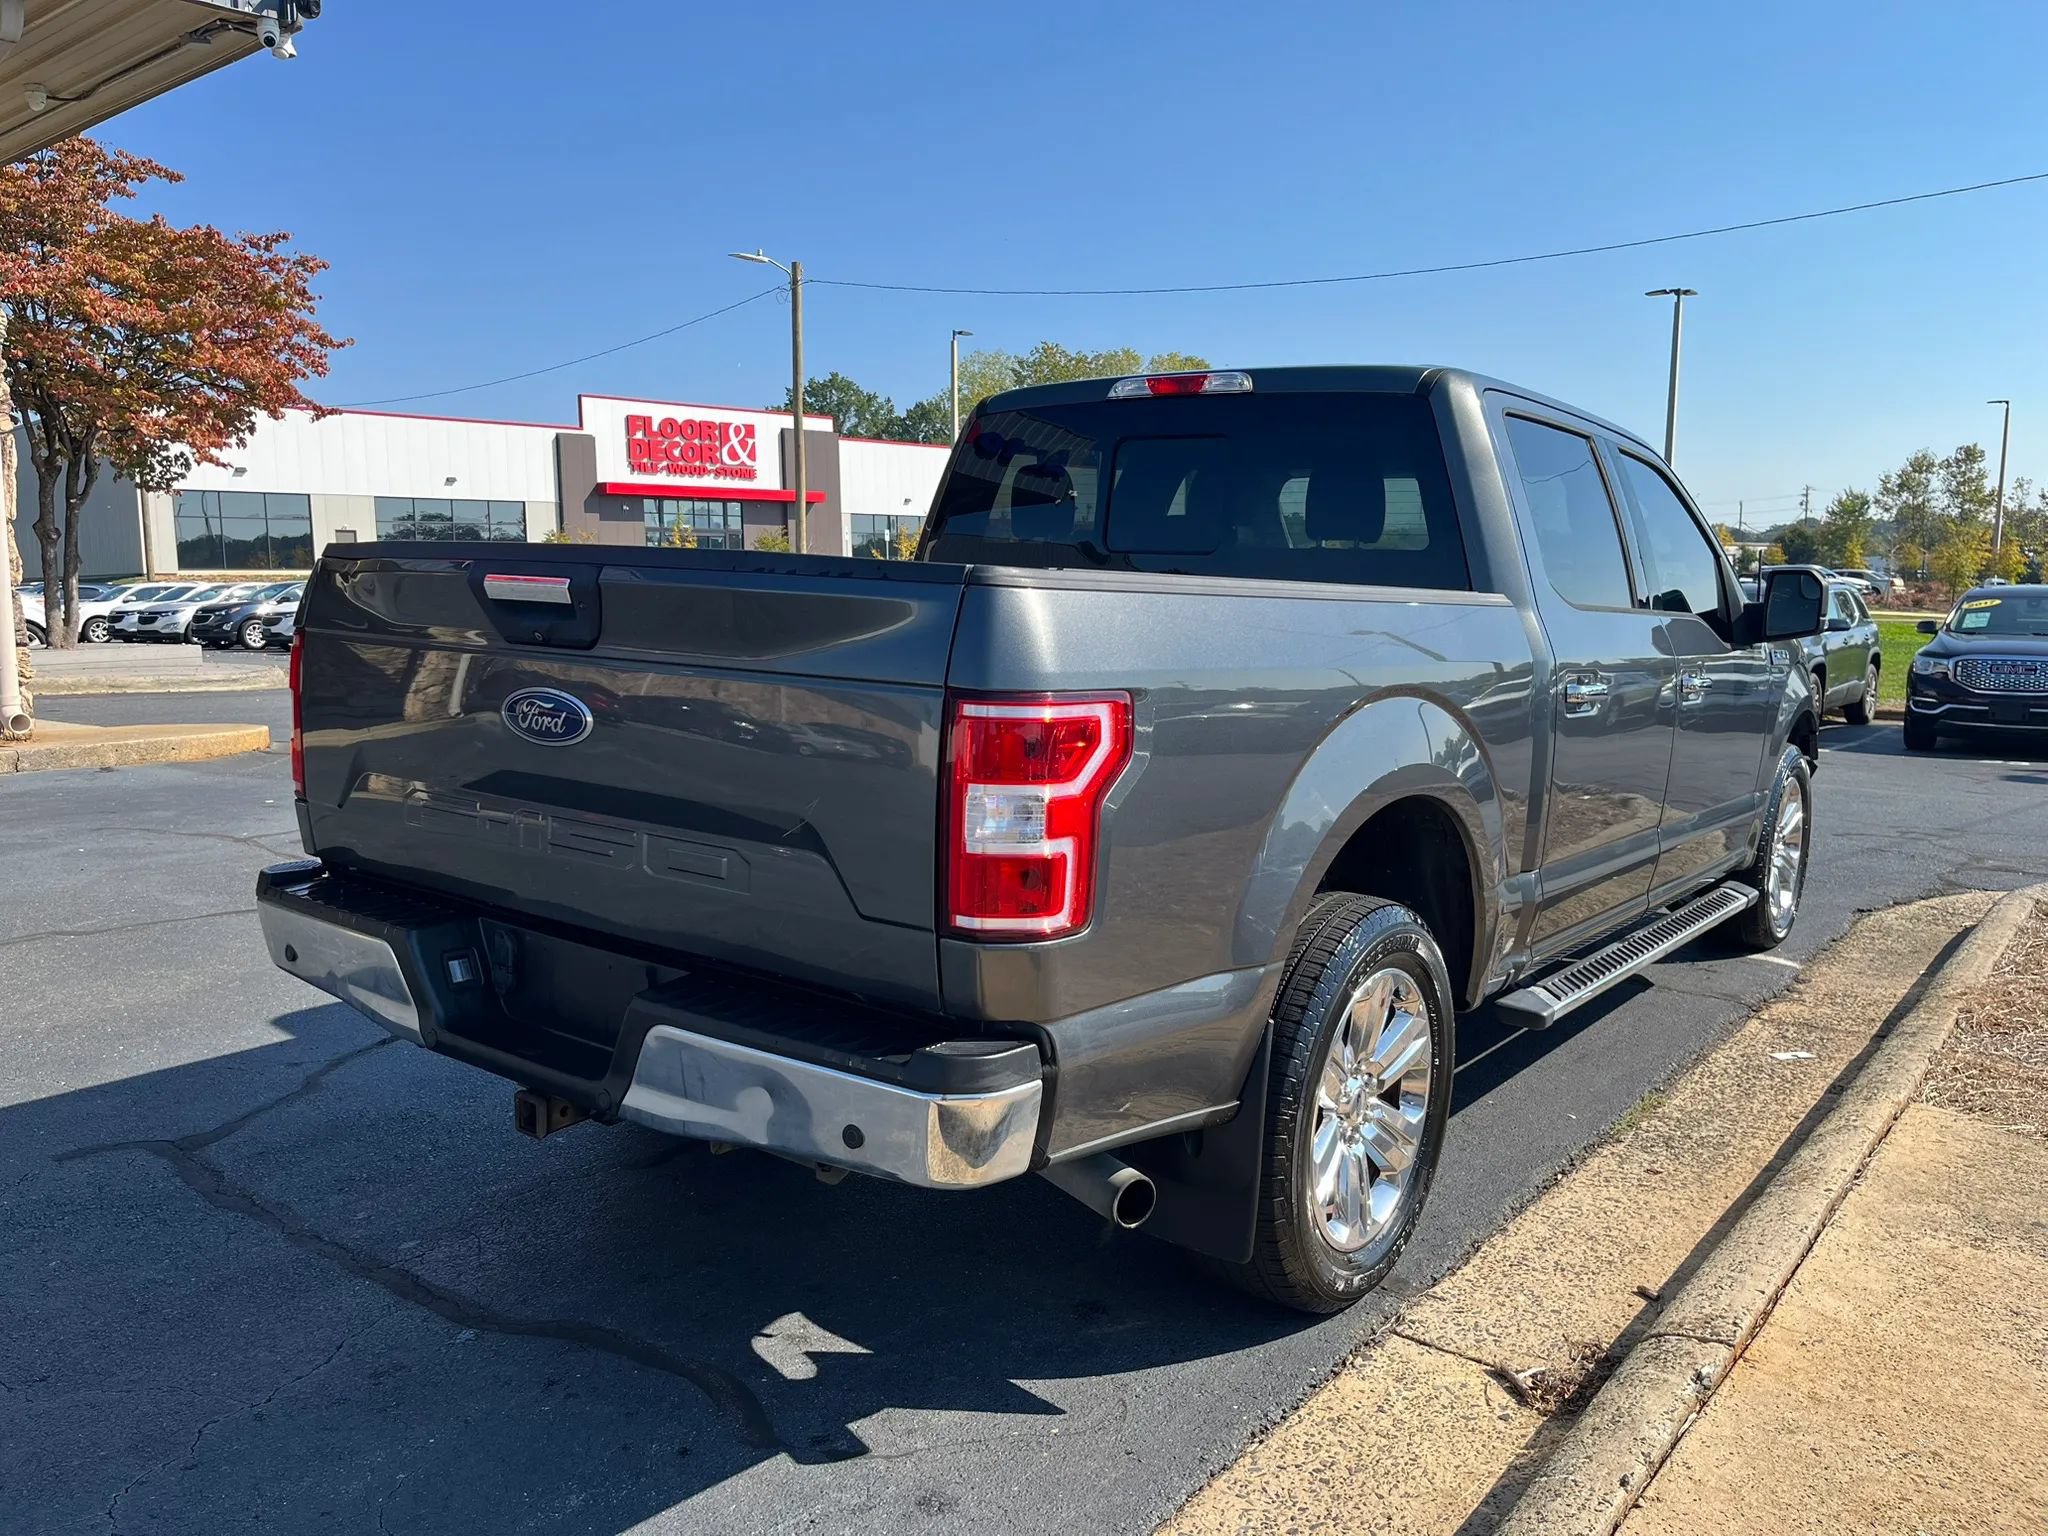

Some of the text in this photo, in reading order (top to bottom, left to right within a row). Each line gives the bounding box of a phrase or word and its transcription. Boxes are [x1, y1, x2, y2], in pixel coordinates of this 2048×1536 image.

[626, 415, 757, 466] FLOOR &
[628, 438, 720, 465] DECOR
[668, 463, 708, 476] WOOD
[715, 467, 758, 480] STONE
[1991, 664, 2036, 675] GMC
[517, 698, 567, 734] Ford
